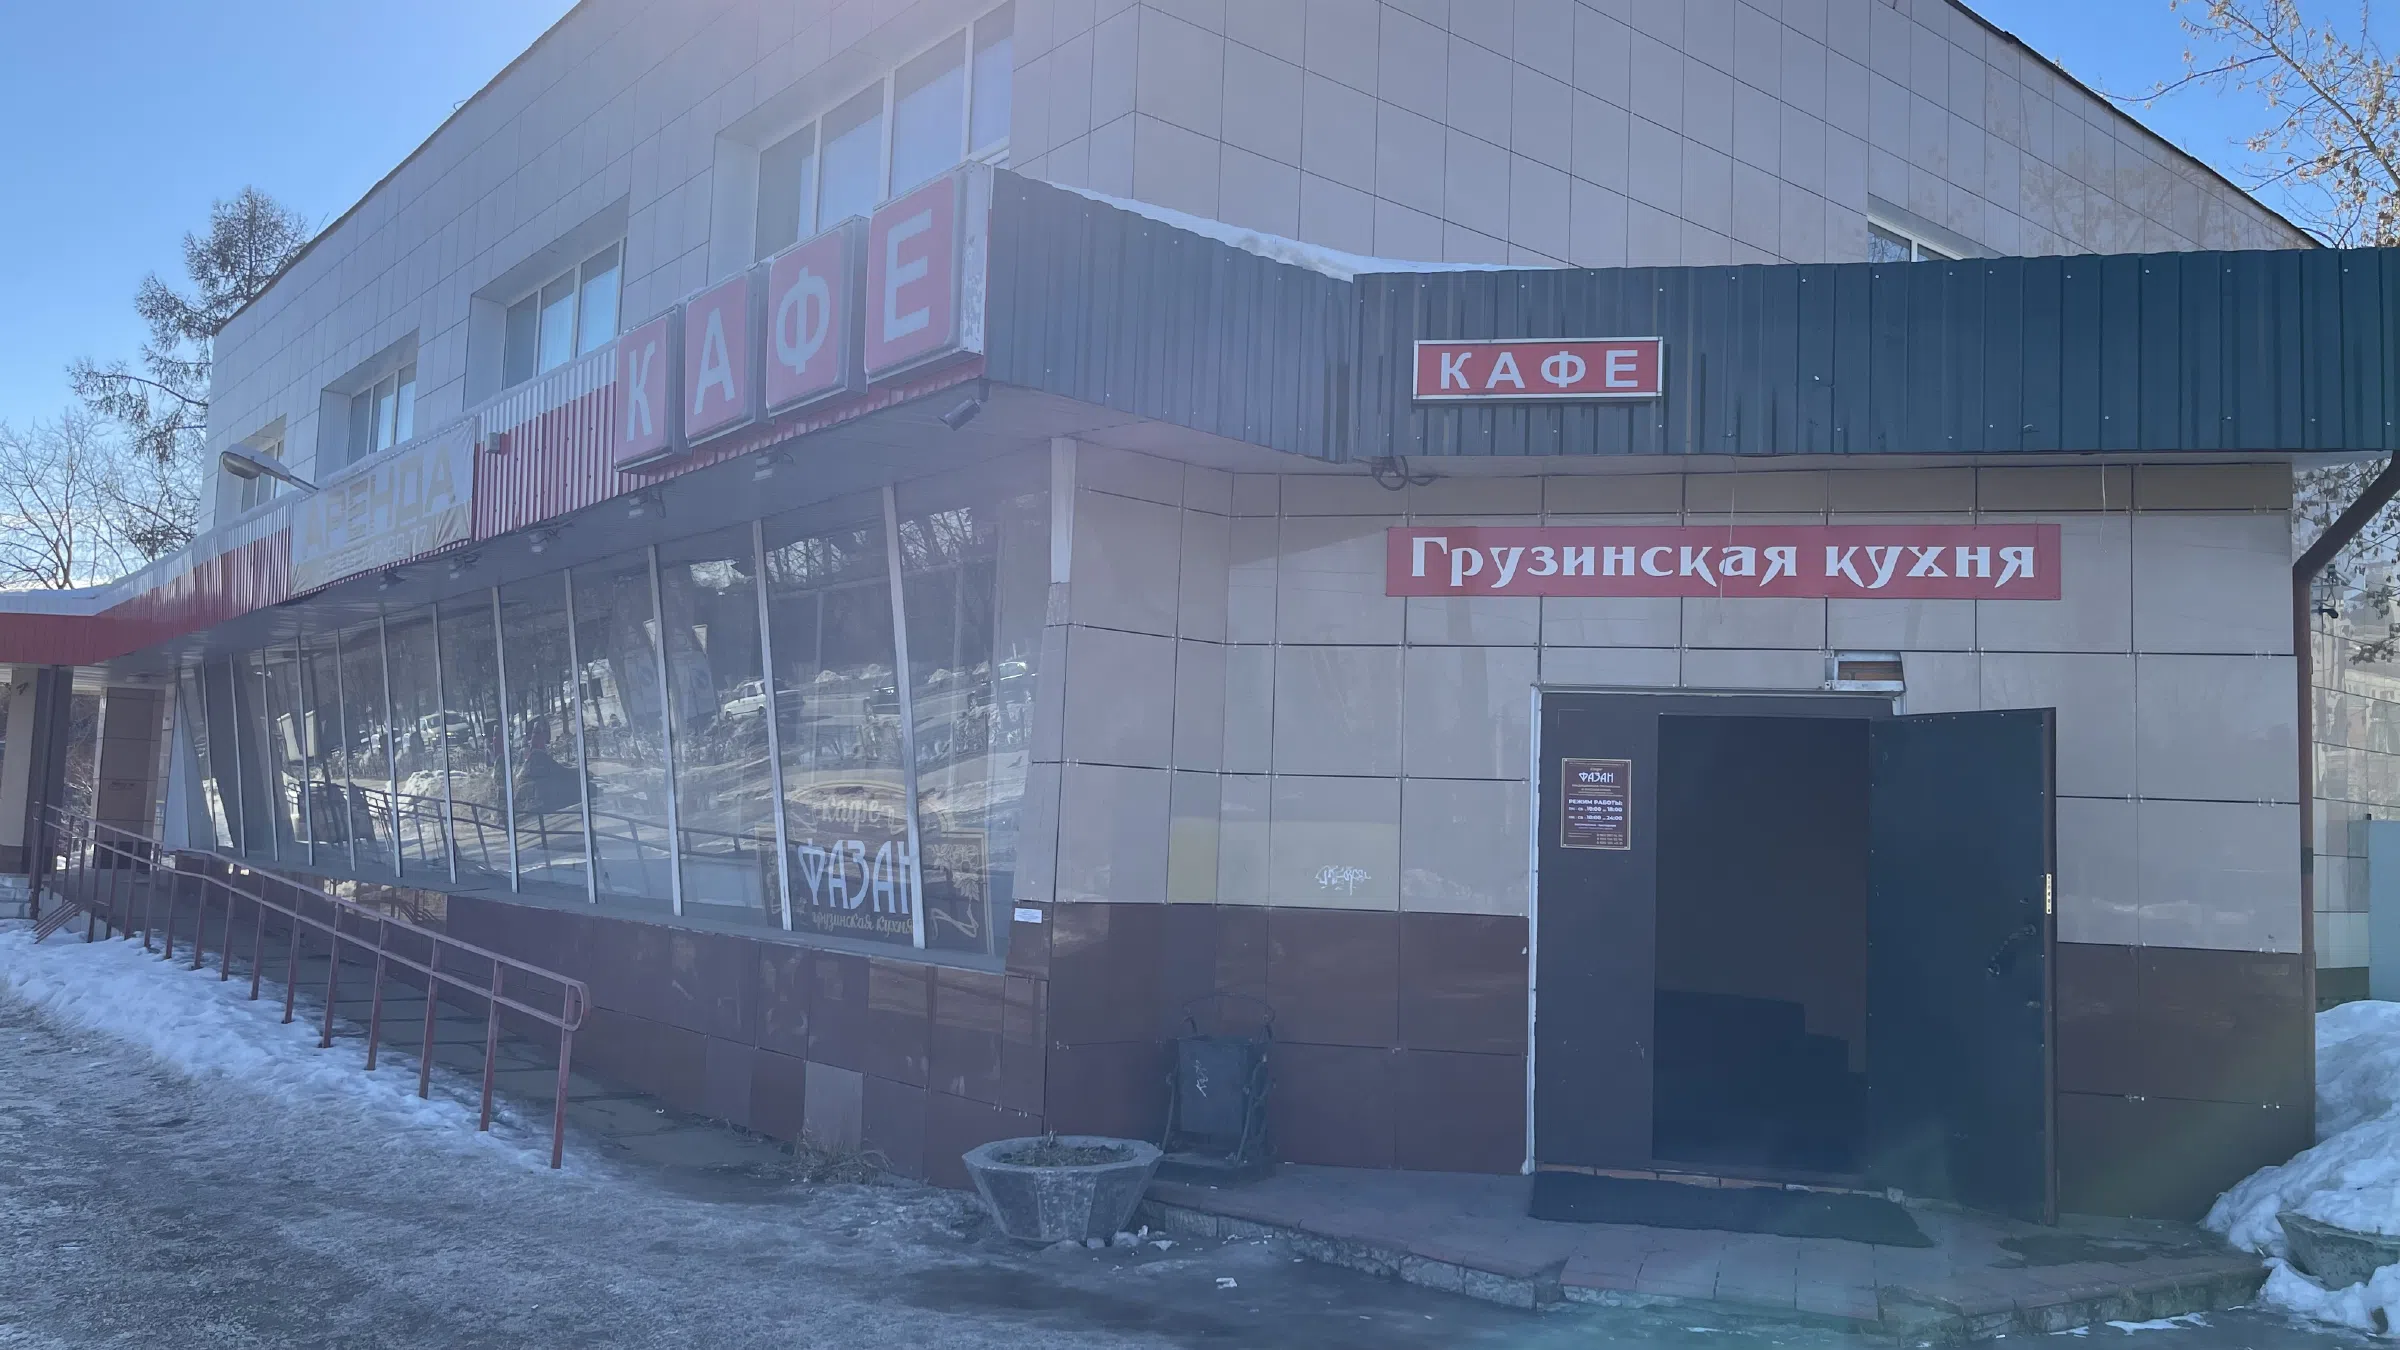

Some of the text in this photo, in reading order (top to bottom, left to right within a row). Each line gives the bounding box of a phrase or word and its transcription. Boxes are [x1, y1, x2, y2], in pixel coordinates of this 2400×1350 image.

[627, 208, 932, 442] КАФЕ
[1440, 350, 1638, 389] КАФЕ
[305, 444, 456, 548] АРЕНДА
[1411, 536, 2035, 589] Грузинская кухня
[1578, 772, 1614, 783] ФАЗАН
